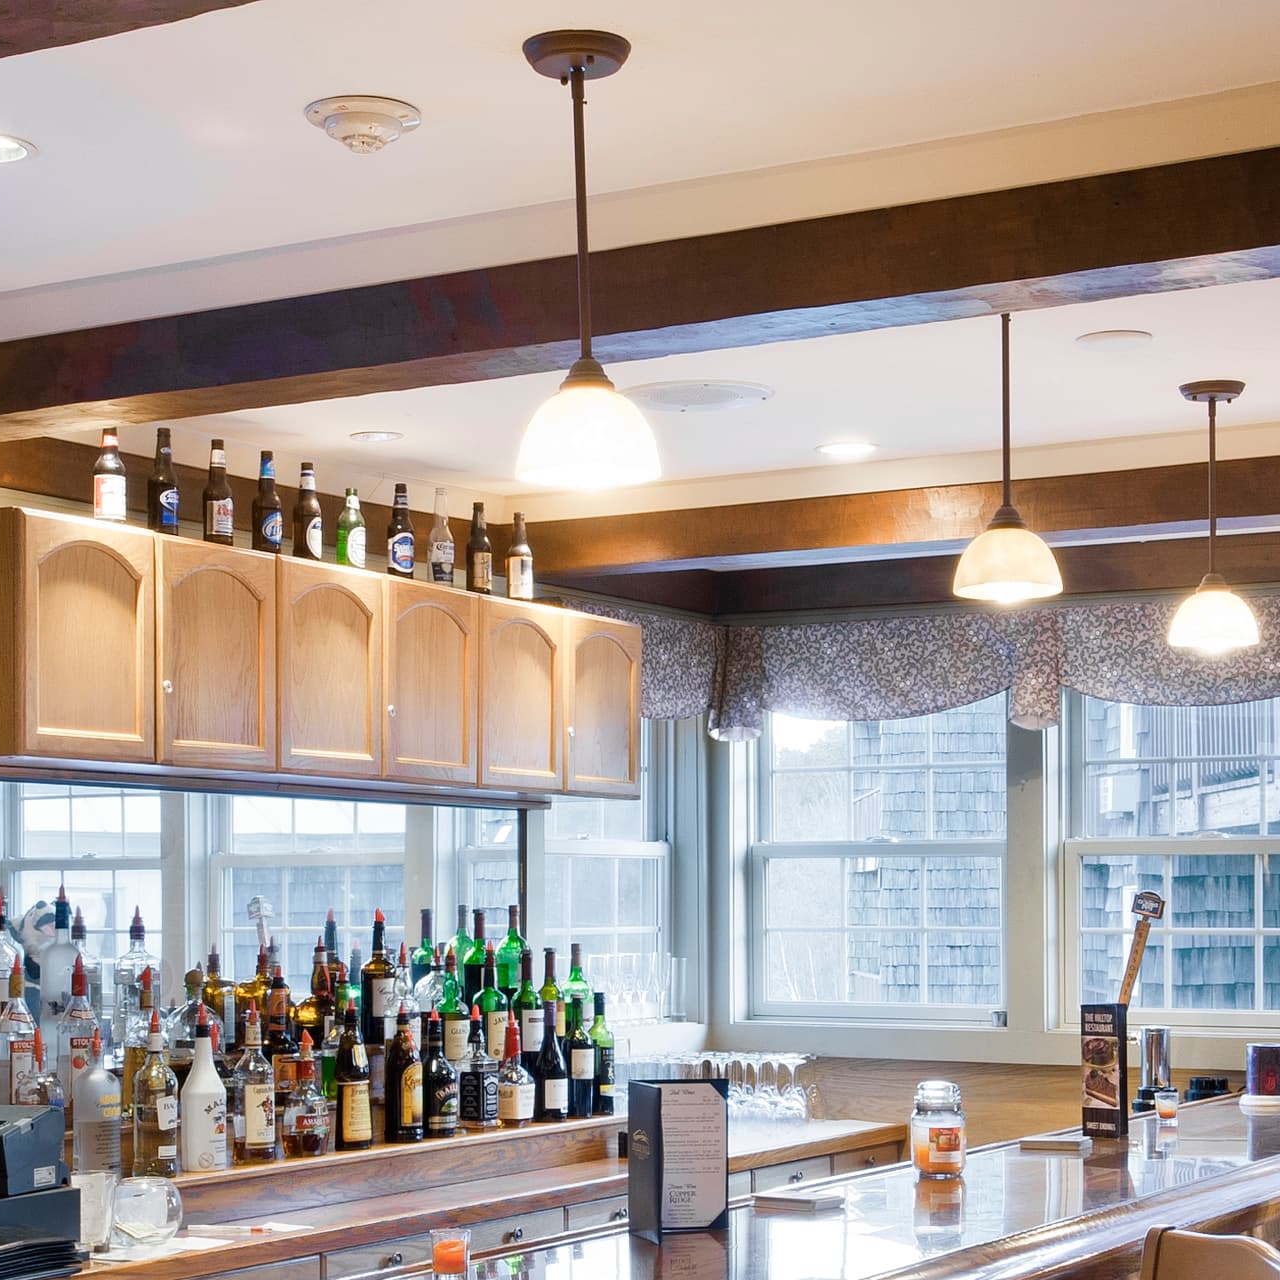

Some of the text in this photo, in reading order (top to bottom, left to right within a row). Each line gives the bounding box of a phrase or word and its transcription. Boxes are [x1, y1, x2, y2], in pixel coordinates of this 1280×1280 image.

[1085, 1013, 1113, 1023] THE HILLTOP
[1085, 1023, 1114, 1033] RESTAURANT
